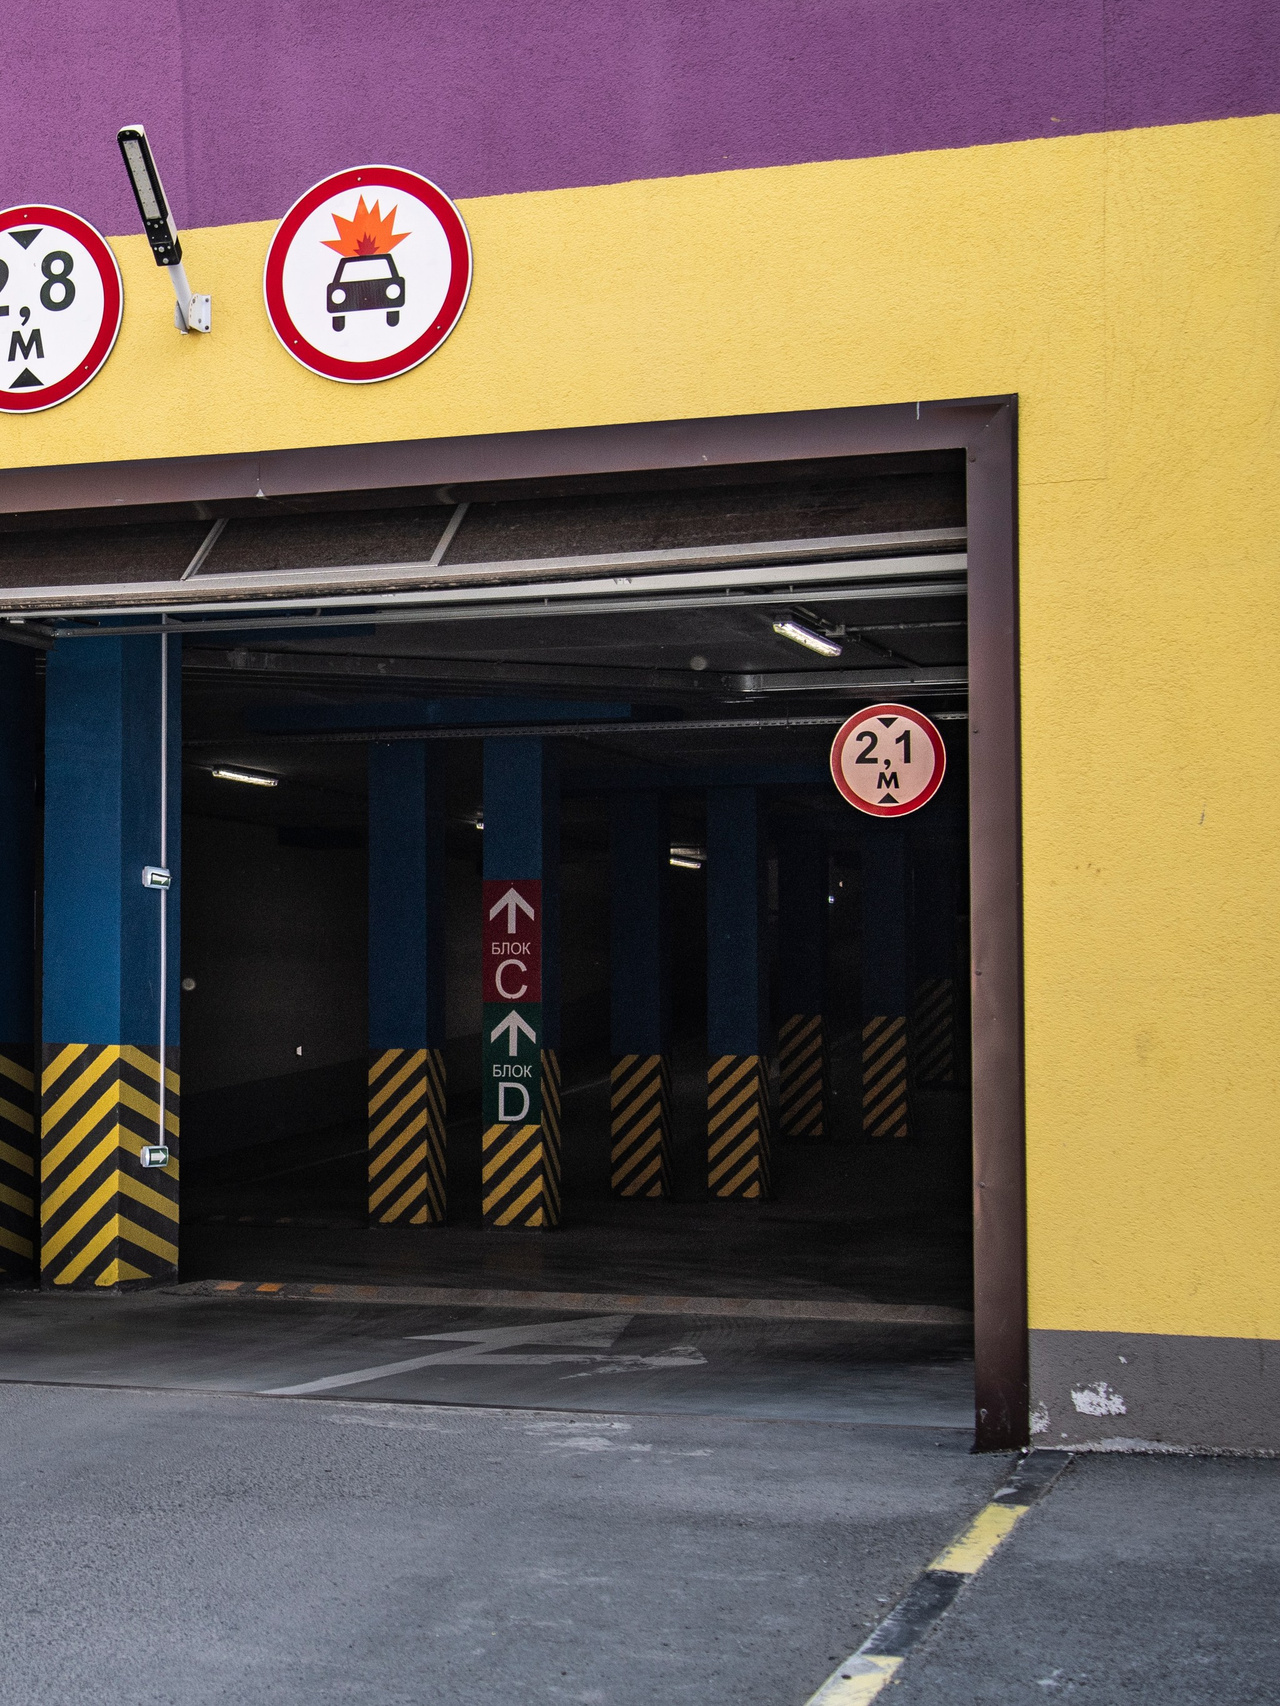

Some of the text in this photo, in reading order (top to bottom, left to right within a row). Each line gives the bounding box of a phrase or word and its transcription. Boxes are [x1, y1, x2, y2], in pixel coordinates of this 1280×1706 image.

[855, 729, 912, 770] 2,1
[491, 942, 531, 955] БЛОК
[492, 1064, 533, 1078] БЛОК
[498, 1081, 530, 1122] D
